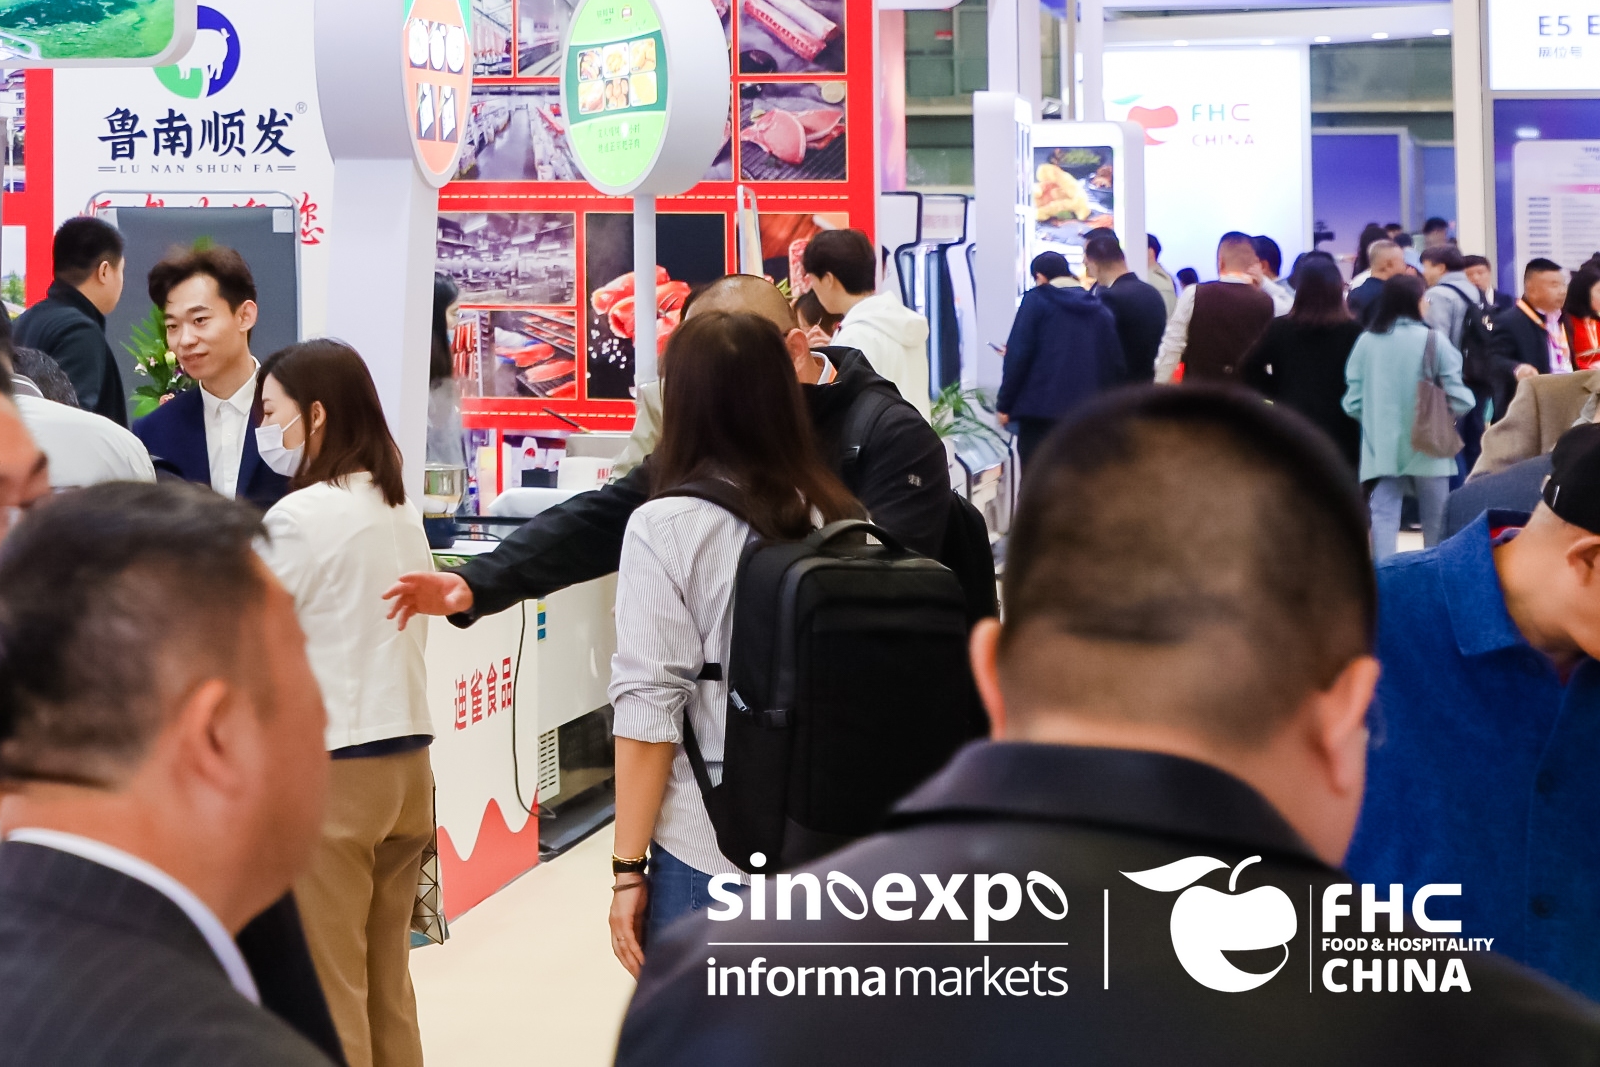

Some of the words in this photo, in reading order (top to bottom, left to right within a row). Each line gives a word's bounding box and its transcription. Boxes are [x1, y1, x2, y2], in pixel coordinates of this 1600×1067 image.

[1538, 15, 1572, 36] E5
[1191, 104, 1250, 121] FHC
[97, 106, 296, 161] 鲁南顺发
[1191, 134, 1255, 147] CHINA
[119, 164, 140, 174] LU
[151, 164, 186, 173] NAN
[196, 164, 242, 174] SHUN
[254, 164, 274, 173] FA
[454, 656, 512, 732] 迪雀食品
